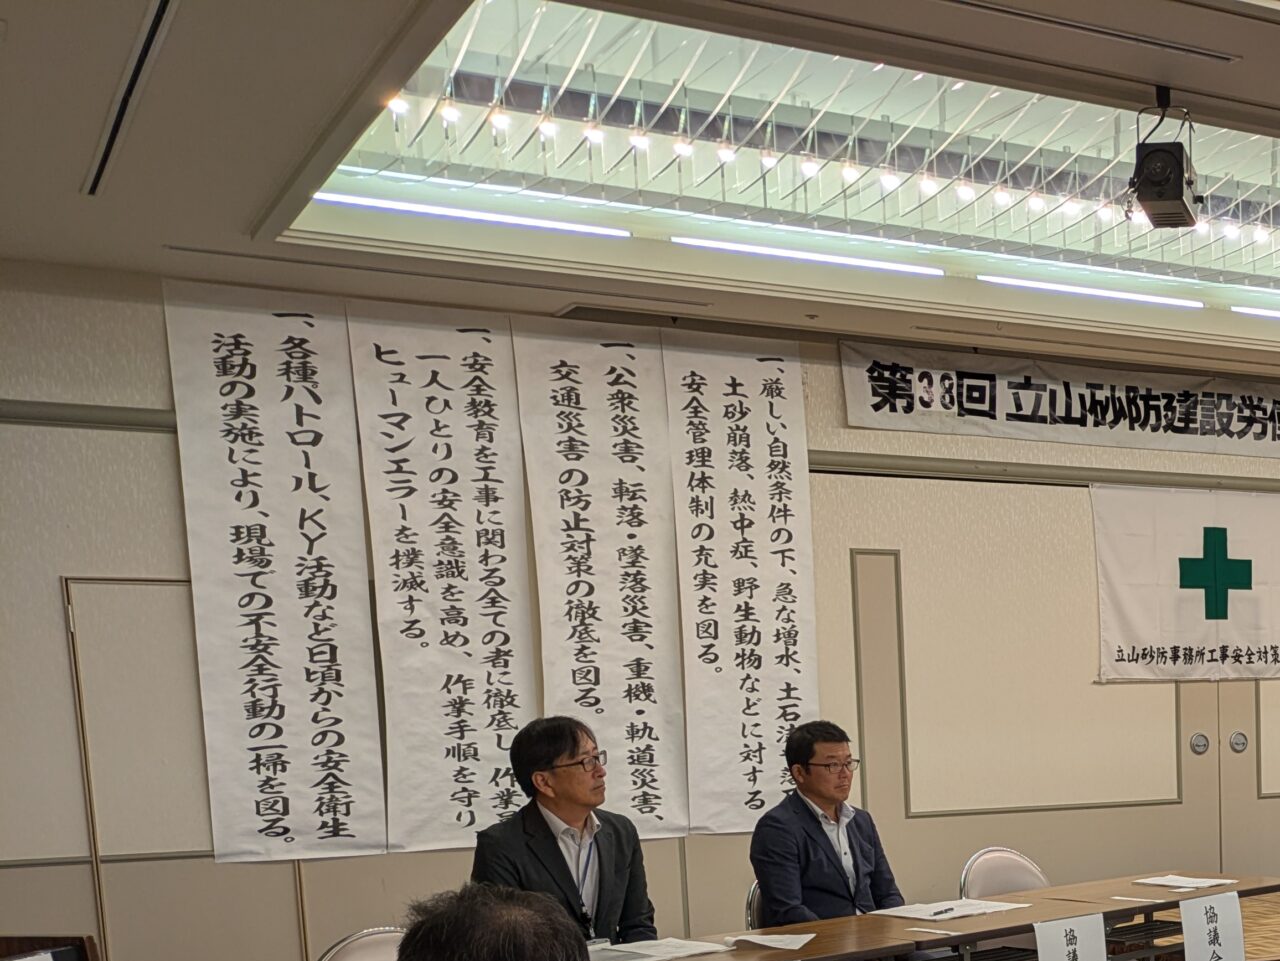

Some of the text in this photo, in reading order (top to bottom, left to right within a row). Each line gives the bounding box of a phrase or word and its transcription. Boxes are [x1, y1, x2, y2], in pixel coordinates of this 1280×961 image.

[373, 343, 429, 648] ヒューマンエラーを撲滅する。
[549, 360, 604, 715] 交通災害の防止対策の徹底を図る。
[680, 370, 722, 673] 安全管理体制の充実を図る。
[722, 376, 767, 810] 土砂崩落、熱中症、野生動物などに対する
